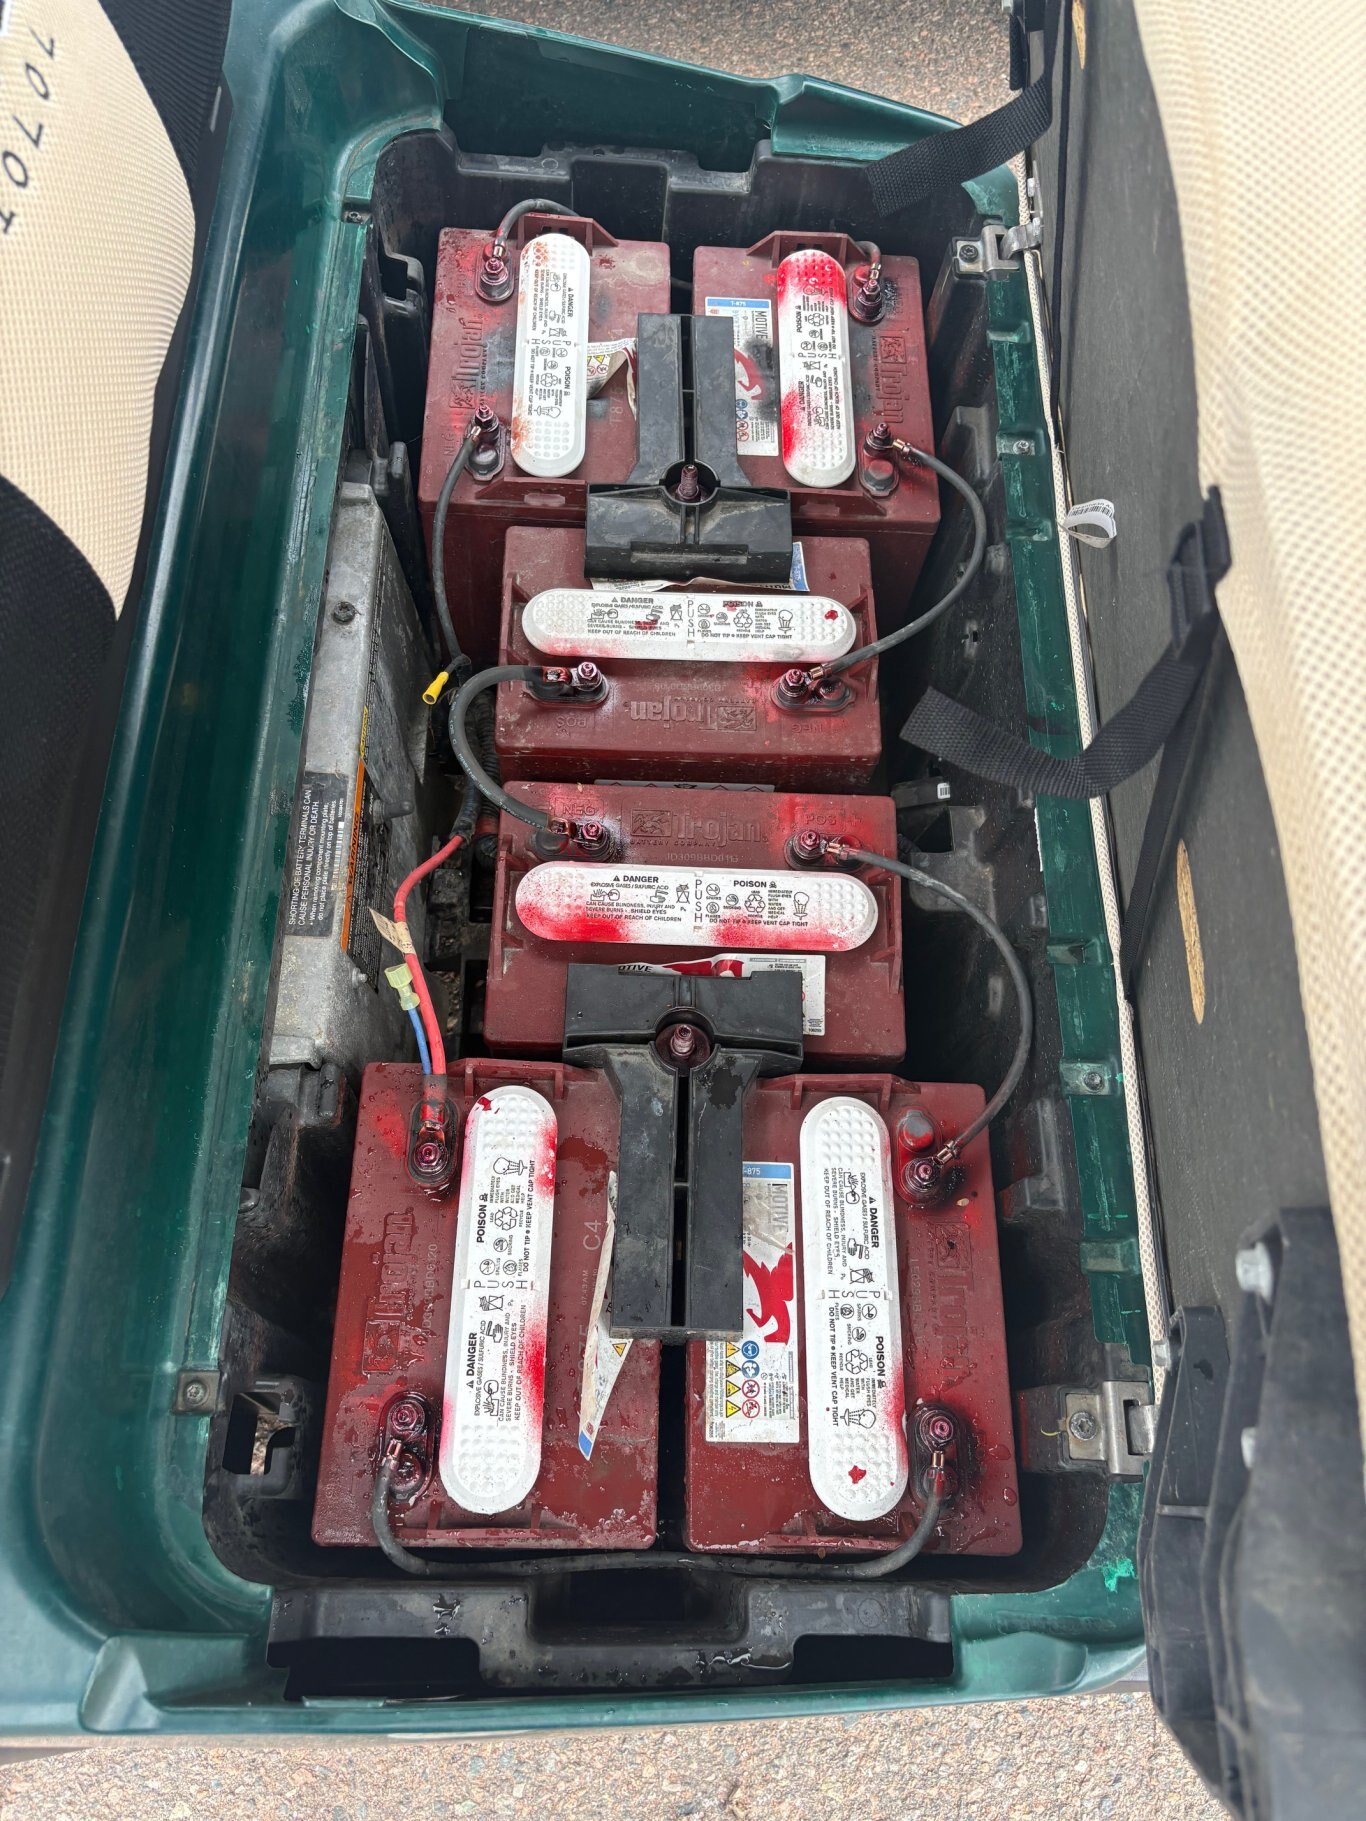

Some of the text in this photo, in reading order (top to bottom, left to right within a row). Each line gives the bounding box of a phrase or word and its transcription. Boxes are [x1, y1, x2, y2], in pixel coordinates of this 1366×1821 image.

[754, 310, 768, 339] MOTIVE
[456, 317, 483, 380] Trojan
[797, 380, 805, 404] DANGER
[879, 363, 909, 424] Trojan
[620, 596, 653, 604] DANGER
[631, 697, 712, 731] Trojan
[328, 799, 336, 824] batteries.
[563, 803, 596, 817] NEG
[805, 813, 836, 825] POS
[298, 804, 309, 844] TERMINALS
[309, 824, 315, 834] OR
[319, 818, 327, 843] mounting
[676, 812, 762, 847] Trojan
[295, 845, 304, 875] BATTERY
[305, 837, 314, 860] INJURY
[315, 843, 325, 875] component
[294, 876, 300, 887] OF
[300, 862, 312, 900] PERSONAL
[623, 874, 658, 883] DANGER
[733, 880, 766, 888] POISON
[319, 885, 327, 901] place
[289, 887, 300, 925] SHORTING
[298, 901, 307, 926] CAUSE
[318, 912, 322, 920] do
[824, 1199, 830, 1207] OF
[476, 1204, 487, 1243] POISON
[582, 1219, 601, 1252] C4
[825, 1232, 832, 1240] OF
[869, 1207, 879, 1248] DANGER
[522, 1262, 529, 1271] DO
[518, 1304, 526, 1337] CHILDREN
[827, 1307, 834, 1316] DO
[478, 1320, 486, 1334] ACID
[827, 1318, 835, 1331] NOT
[466, 1332, 477, 1376] DANGER
[477, 1336, 485, 1361] SULFURIC
[517, 1340, 524, 1349] OF
[875, 1335, 885, 1376] POISON
[500, 1349, 508, 1384] BLINDNESS,
[506, 1374, 514, 1395] BURNS
[515, 1375, 522, 1384] OF
[474, 1386, 482, 1416] EXPLOSIVE
[831, 1406, 839, 1425] TIGHT
